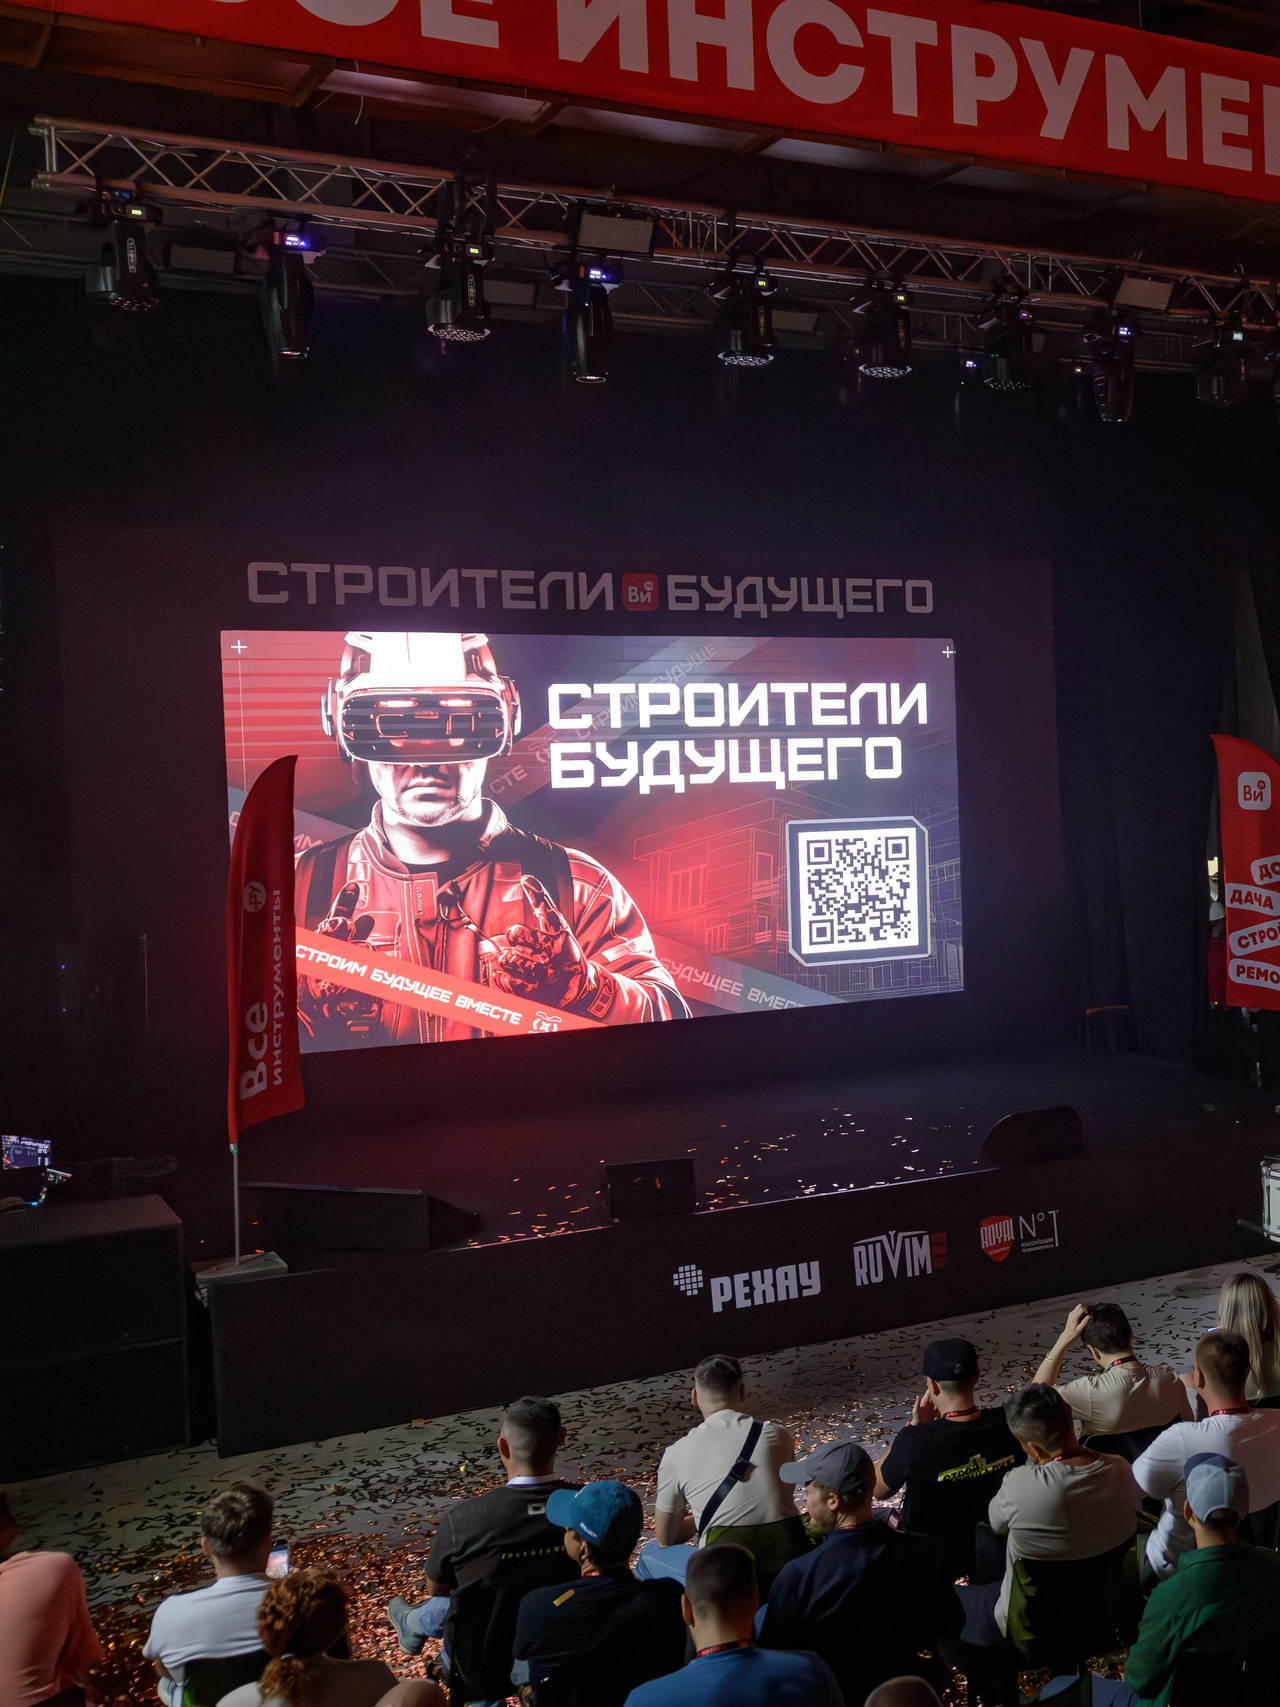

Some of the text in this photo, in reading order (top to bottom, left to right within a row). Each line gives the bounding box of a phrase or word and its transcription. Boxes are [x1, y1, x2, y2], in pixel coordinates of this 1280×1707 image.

[247, 561, 615, 610] СТРОИТЕЛИ
[667, 574, 934, 619] БУДУЩЕГО
[547, 682, 929, 729] СТРОИТЕЛИ
[550, 736, 903, 794] БУДУЩЕГО
[1229, 889, 1274, 911] ДАЧА
[272, 889, 283, 1087] инструменты
[296, 944, 523, 1026] СТРОИМ БУДУЩЕЕ ВМЕСТЕ
[239, 1001, 268, 1101] Все
[853, 1230, 933, 1287] RUVIM
